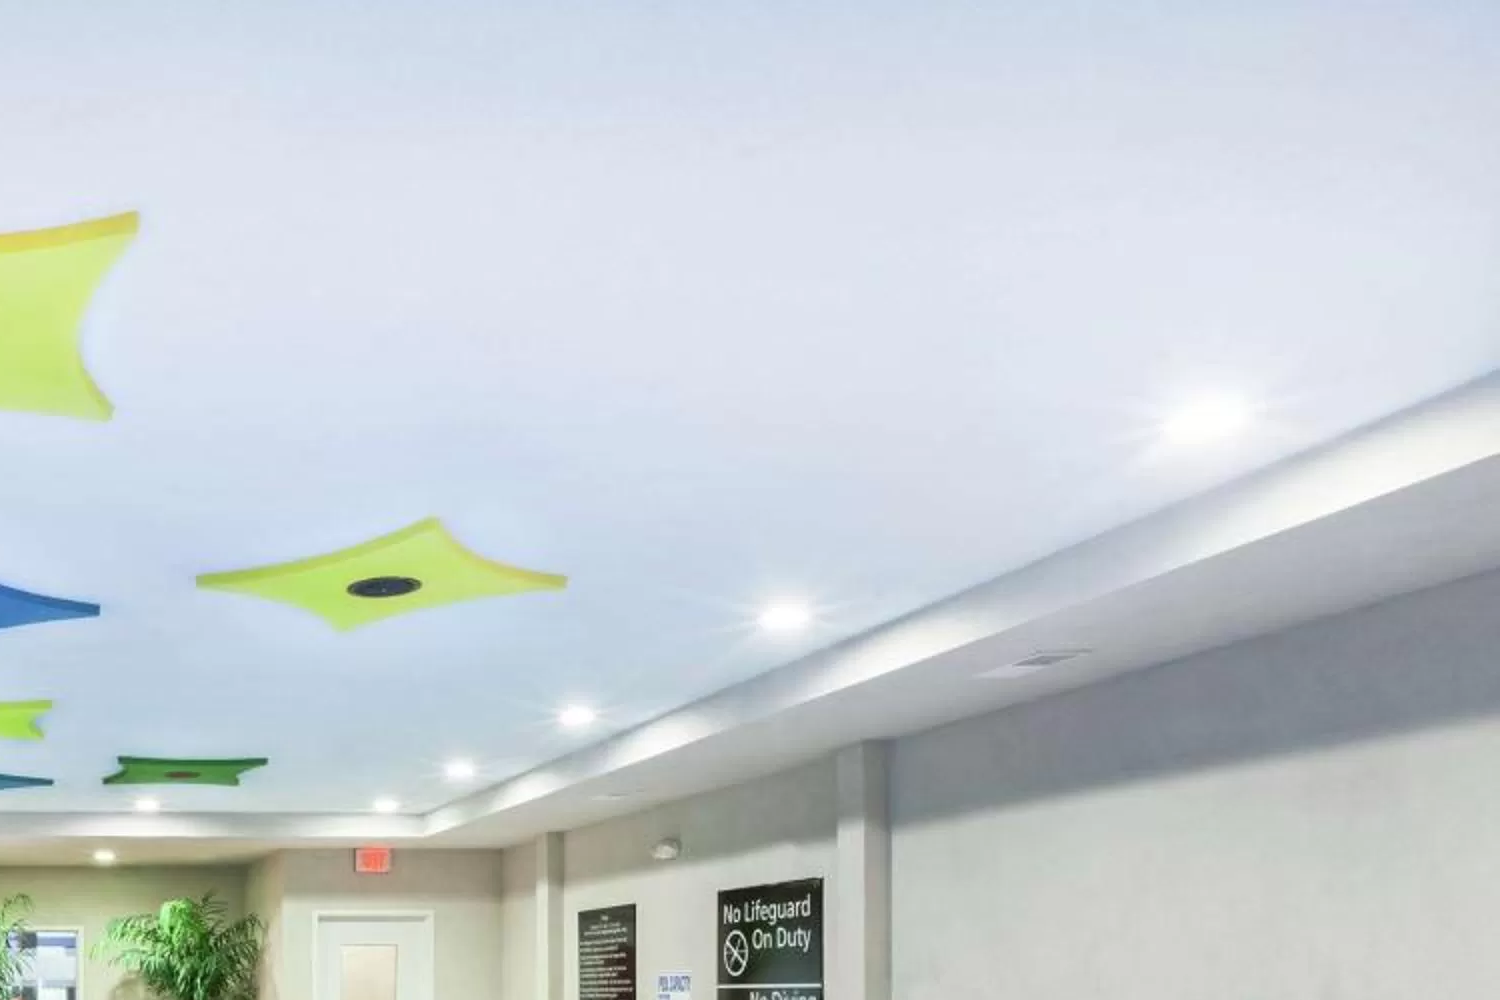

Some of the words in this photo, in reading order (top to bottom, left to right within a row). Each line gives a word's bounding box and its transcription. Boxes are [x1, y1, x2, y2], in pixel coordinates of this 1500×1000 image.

[723, 903, 741, 924] No
[744, 892, 811, 925] Lifeguard
[752, 928, 773, 950] On
[776, 927, 811, 953] Duty
